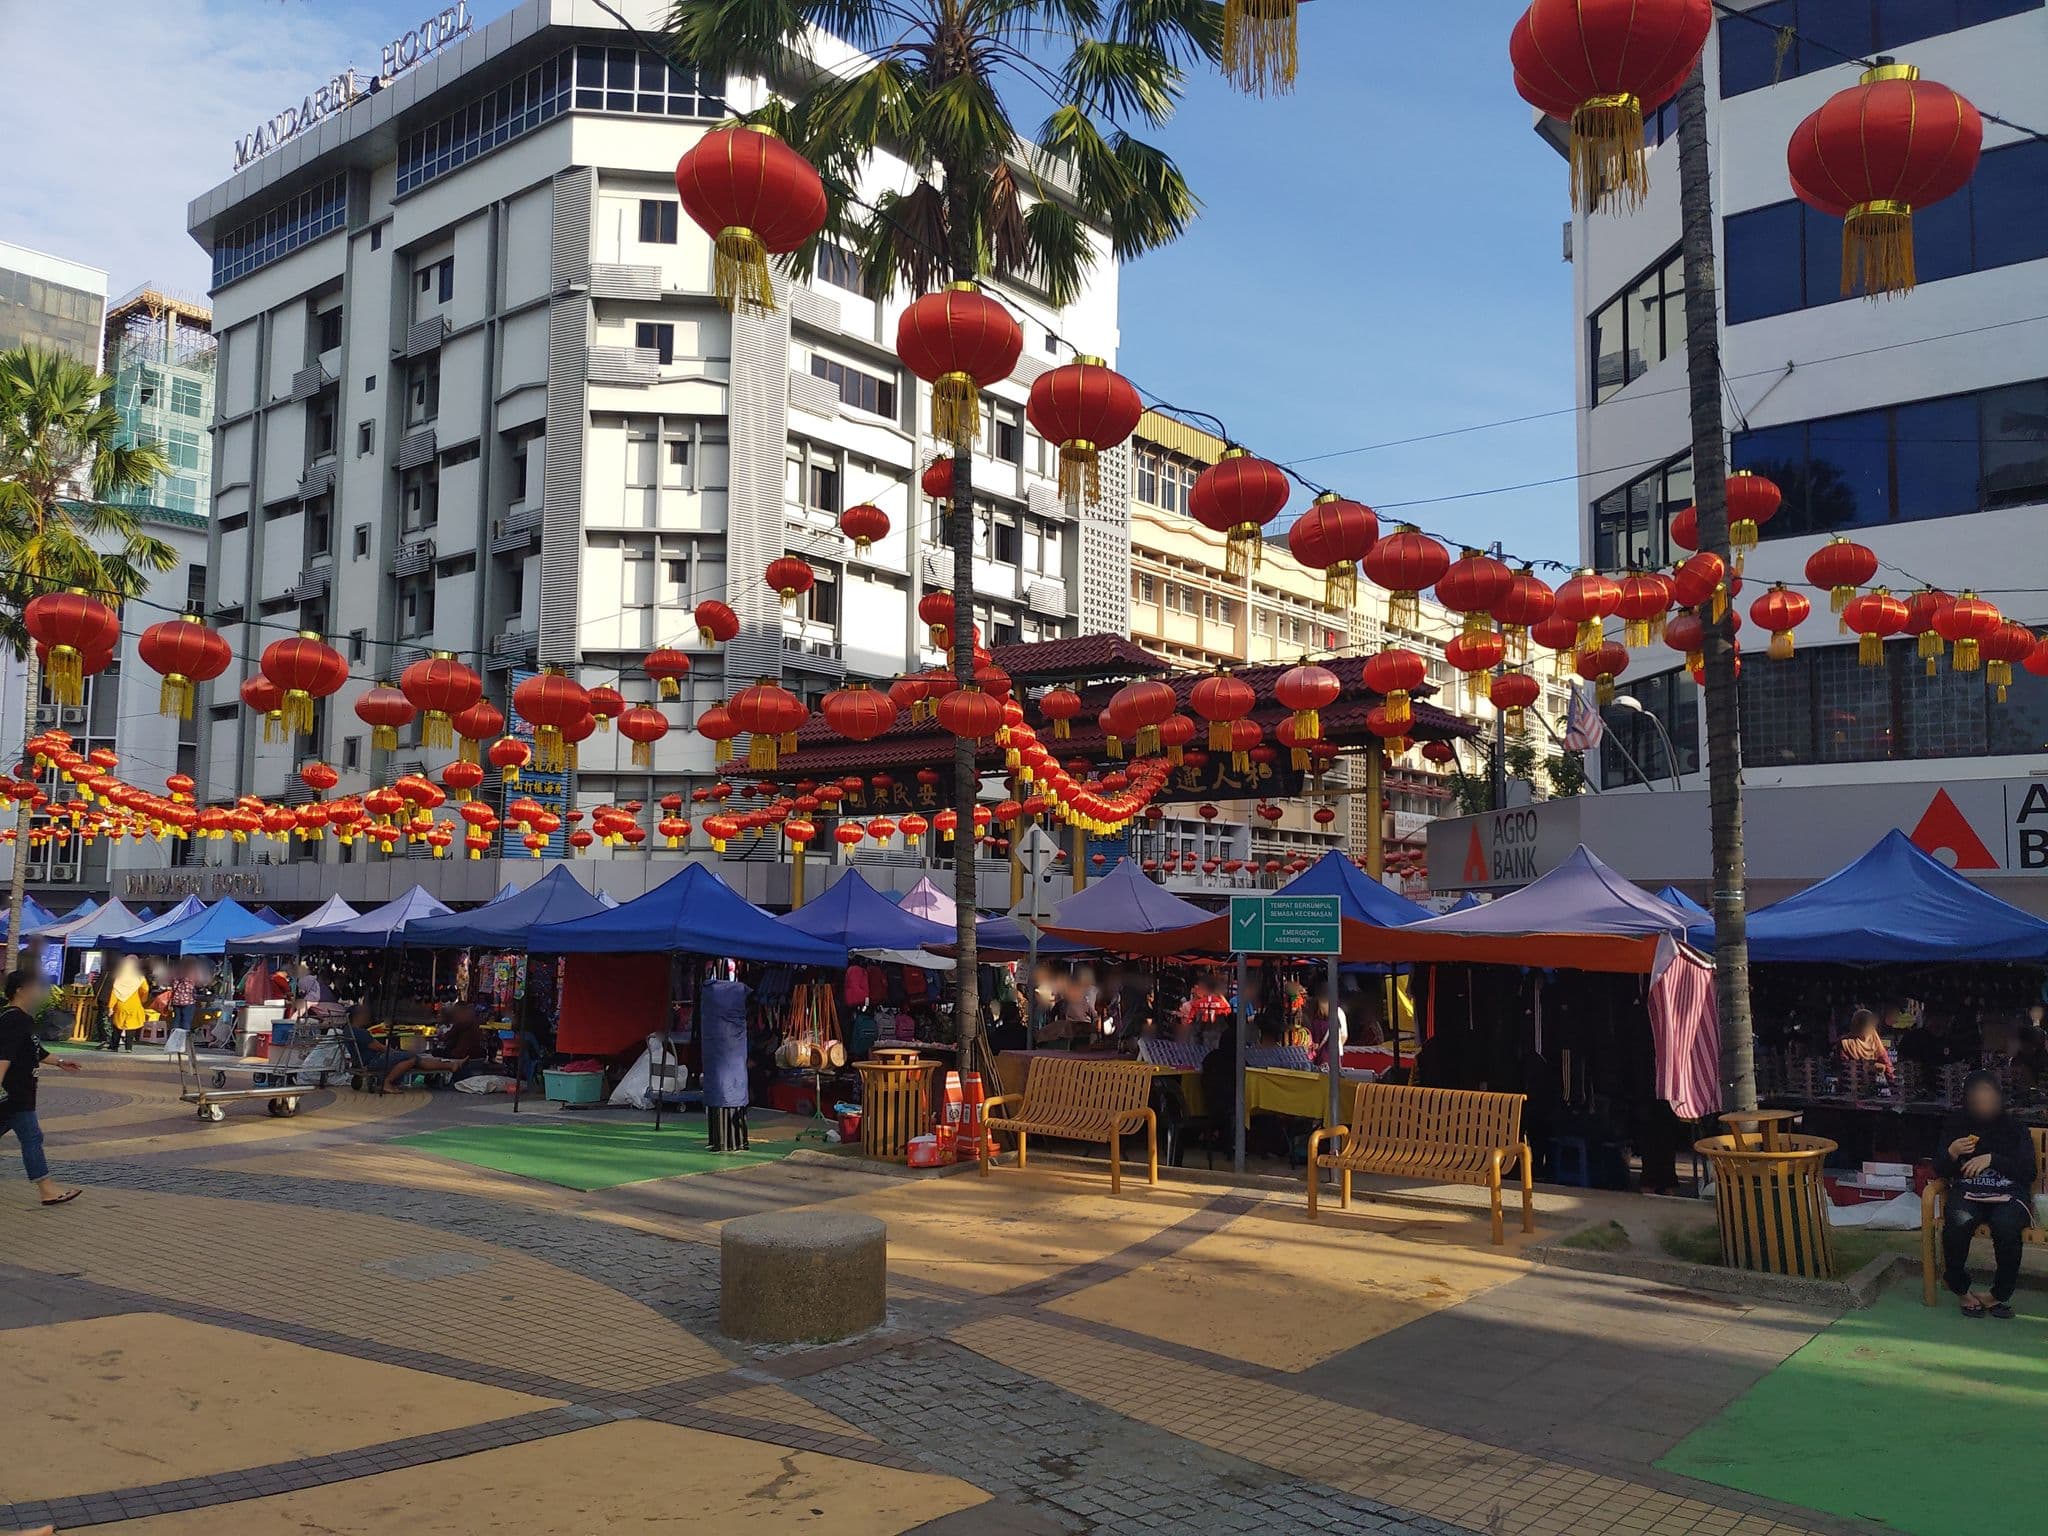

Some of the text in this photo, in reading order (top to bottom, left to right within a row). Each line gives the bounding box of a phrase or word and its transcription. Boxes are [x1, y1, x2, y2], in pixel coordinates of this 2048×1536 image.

[233, 0, 474, 171] MANDARIN HOTEL
[1493, 809, 1538, 846] AGRO
[1493, 846, 1538, 880] BANK
[1295, 910, 1333, 918] KECEMASAN
